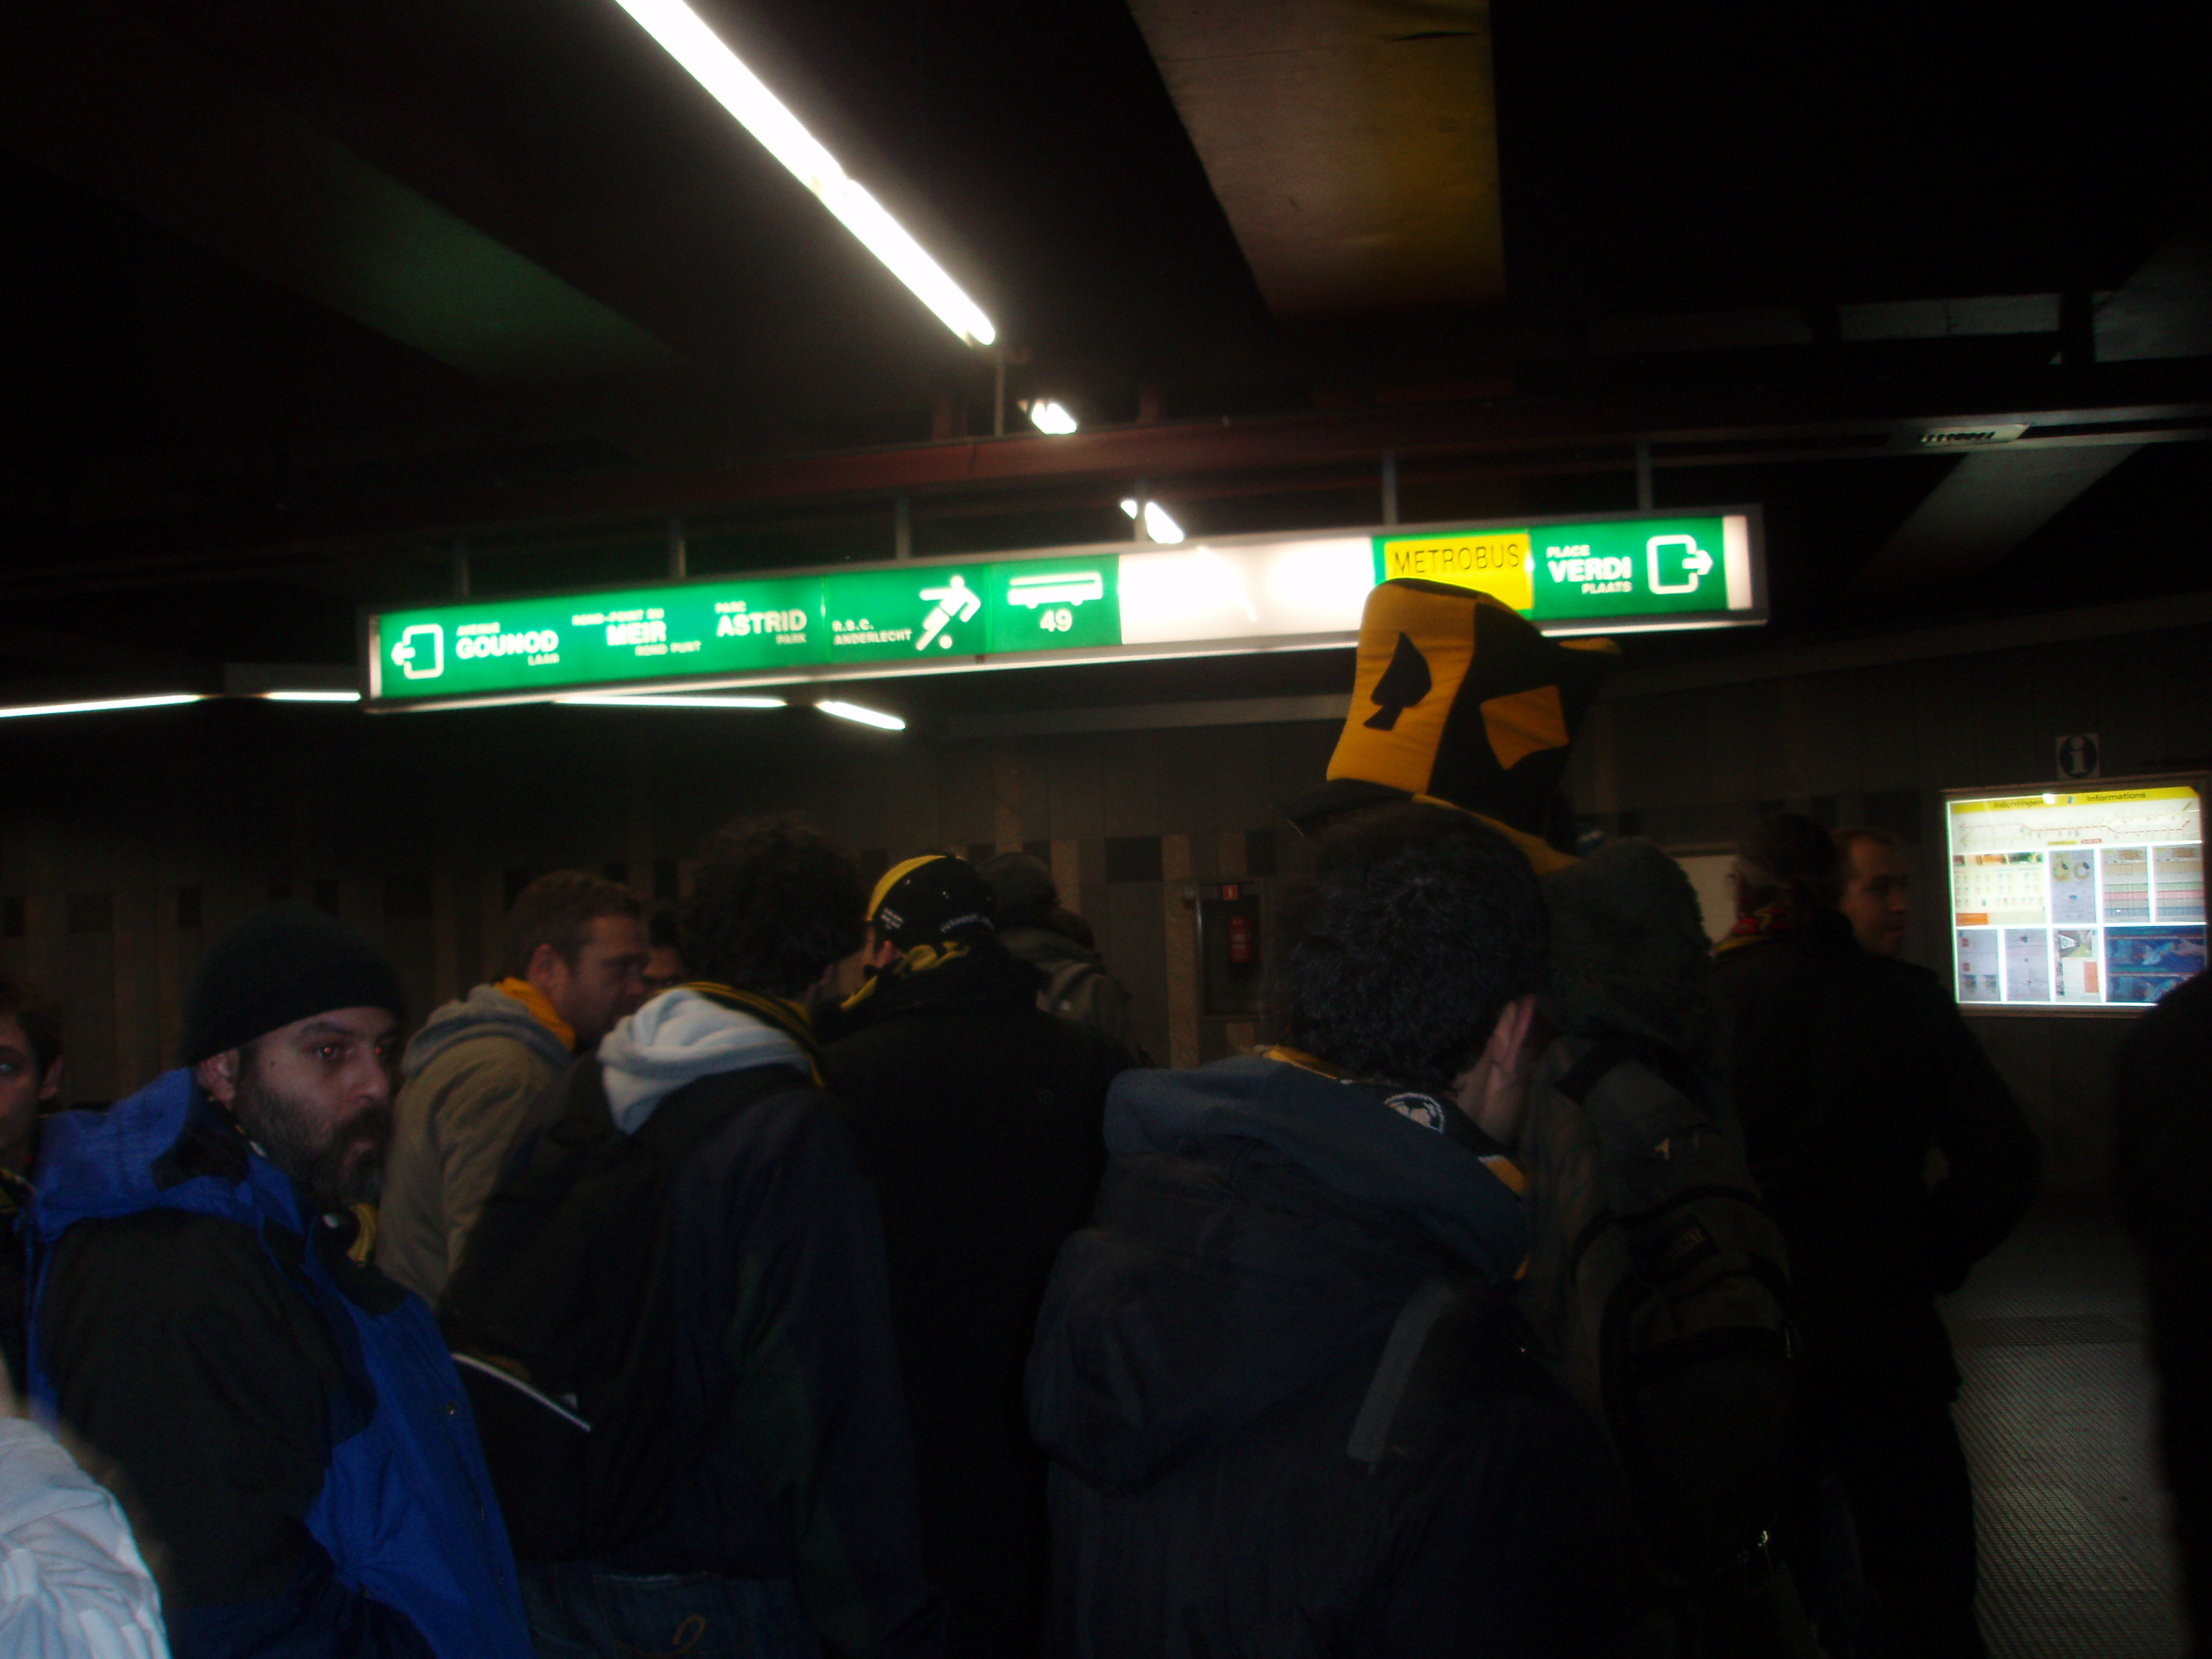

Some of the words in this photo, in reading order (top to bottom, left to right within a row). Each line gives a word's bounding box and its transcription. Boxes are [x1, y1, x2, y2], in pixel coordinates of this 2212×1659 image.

[1395, 544, 1520, 575] METROBUS
[1546, 544, 1591, 558] PLACE
[1547, 556, 1632, 583] VERDI
[1581, 580, 1632, 594] PLAATS
[716, 608, 807, 637] ASTRID
[1040, 610, 1073, 632] 49
[456, 629, 559, 660] GOUNOD
[606, 621, 667, 646] MEIR
[834, 628, 912, 645] ANDERLECHT
[2087, 792, 2146, 802] Informations
